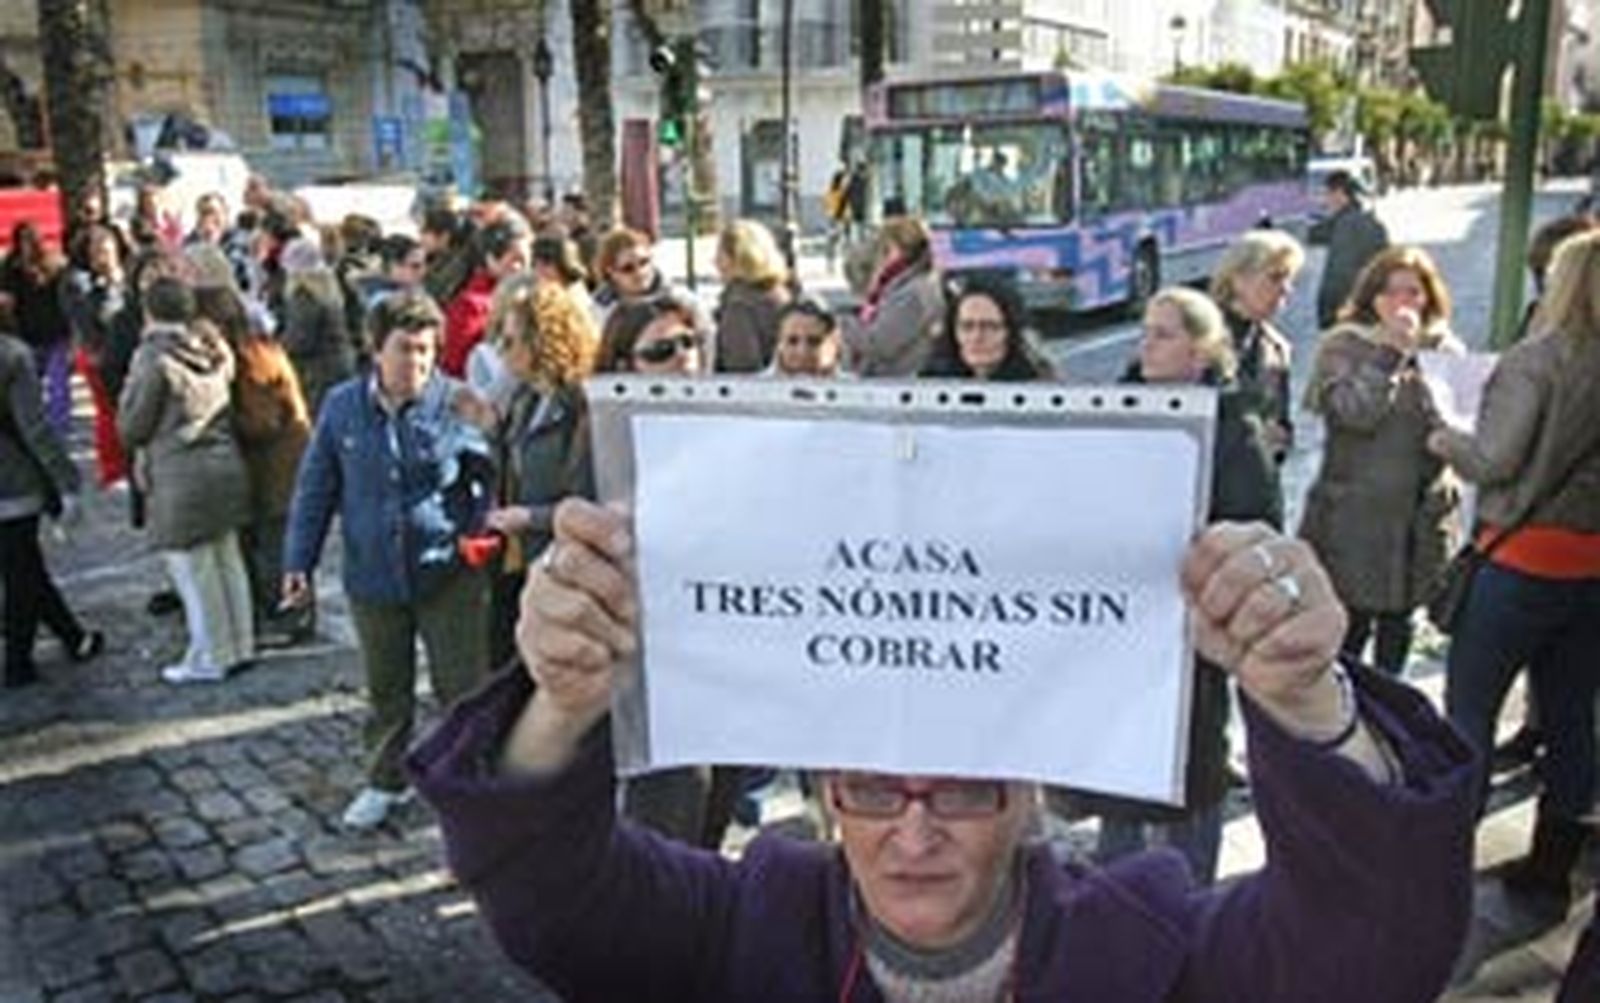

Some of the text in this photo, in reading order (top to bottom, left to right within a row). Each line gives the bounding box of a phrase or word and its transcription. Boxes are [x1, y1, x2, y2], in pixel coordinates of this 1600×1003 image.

[826, 538, 981, 577] ACASA
[685, 578, 1128, 625] TRES NÓMINAS SIN
[806, 633, 1002, 672] COBRAR
